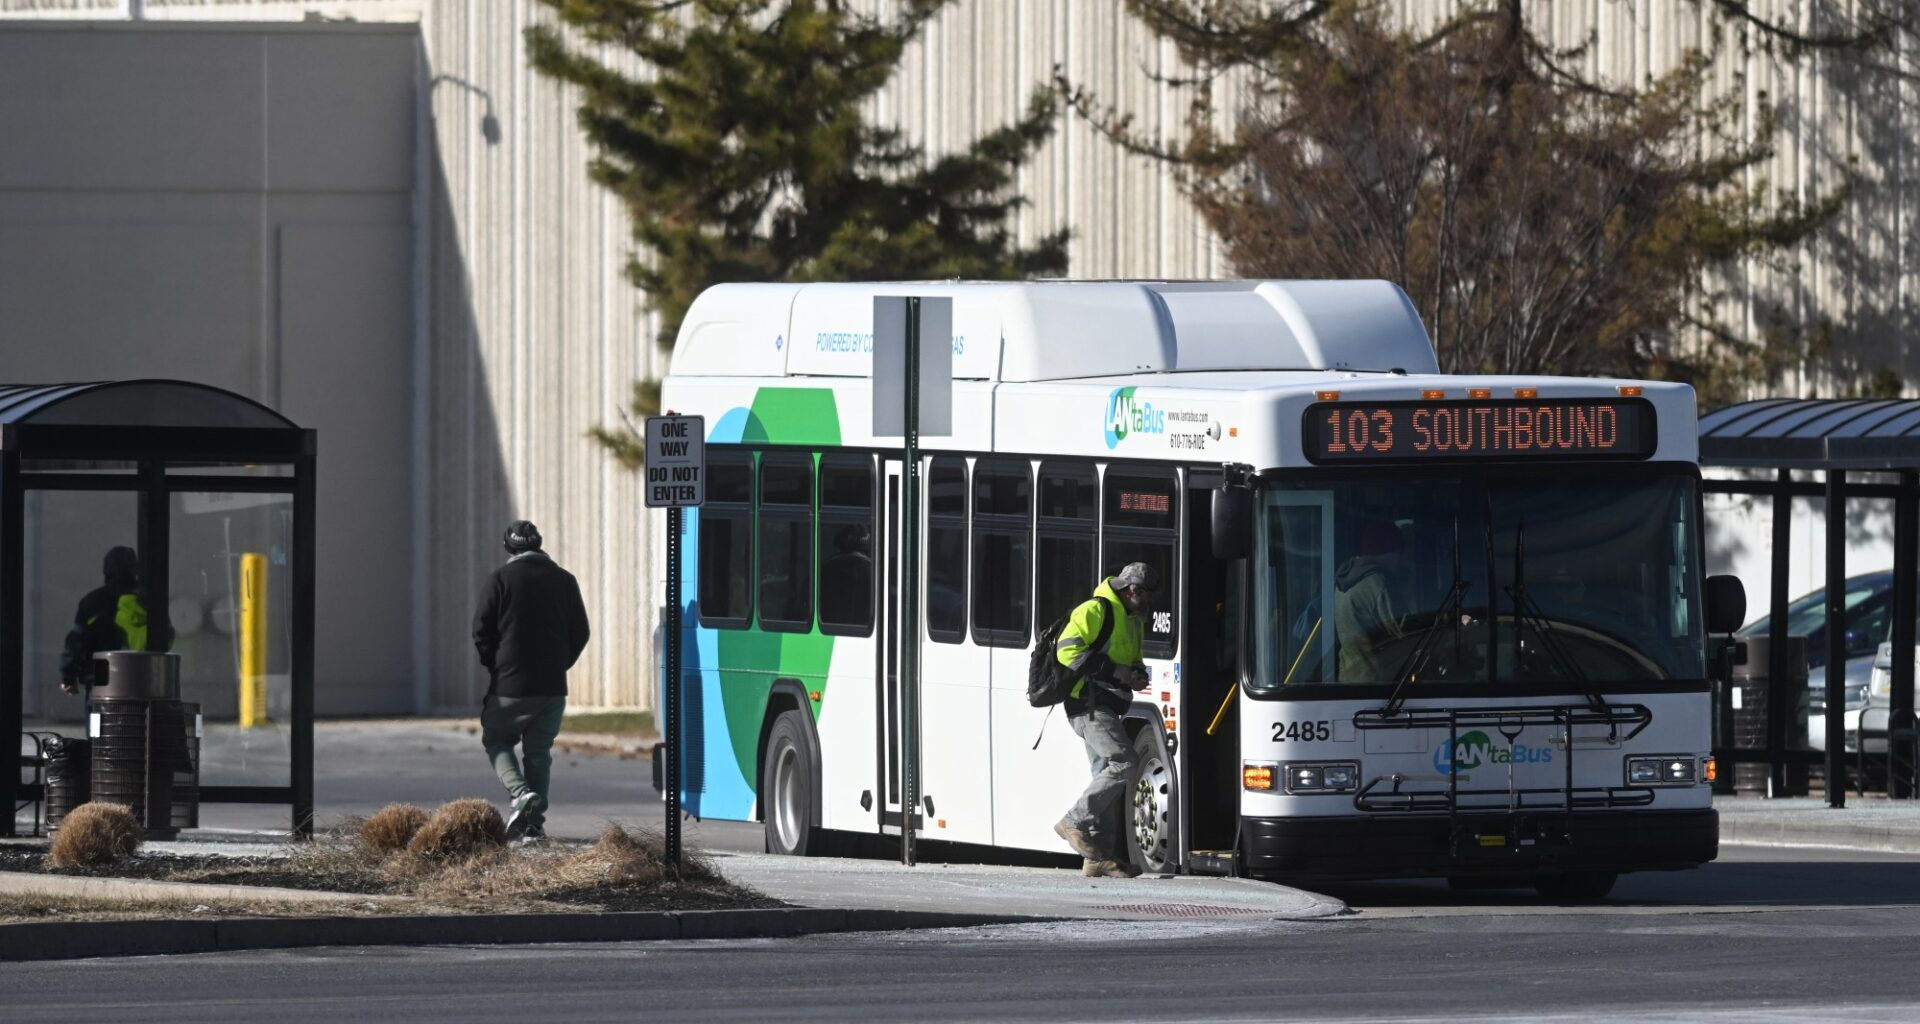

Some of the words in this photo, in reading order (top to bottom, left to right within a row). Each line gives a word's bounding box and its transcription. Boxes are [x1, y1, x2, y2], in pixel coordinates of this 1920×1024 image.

[816, 333, 851, 352] POWERED
[852, 334, 863, 353] BY
[952, 335, 964, 355] AS
[1168, 409, 1208, 423] www.lantabus.com
[661, 422, 688, 438] ONE
[1327, 409, 1393, 452] 103
[1412, 405, 1617, 451] SOUTHBOUND
[660, 441, 689, 457] WAY
[1170, 433, 1205, 450] 610-776-RIDE
[649, 467, 668, 482] DO
[672, 466, 700, 482] NOT
[654, 486, 696, 501] ENTER
[1152, 611, 1171, 633] 2485
[1271, 720, 1330, 742] 2485
